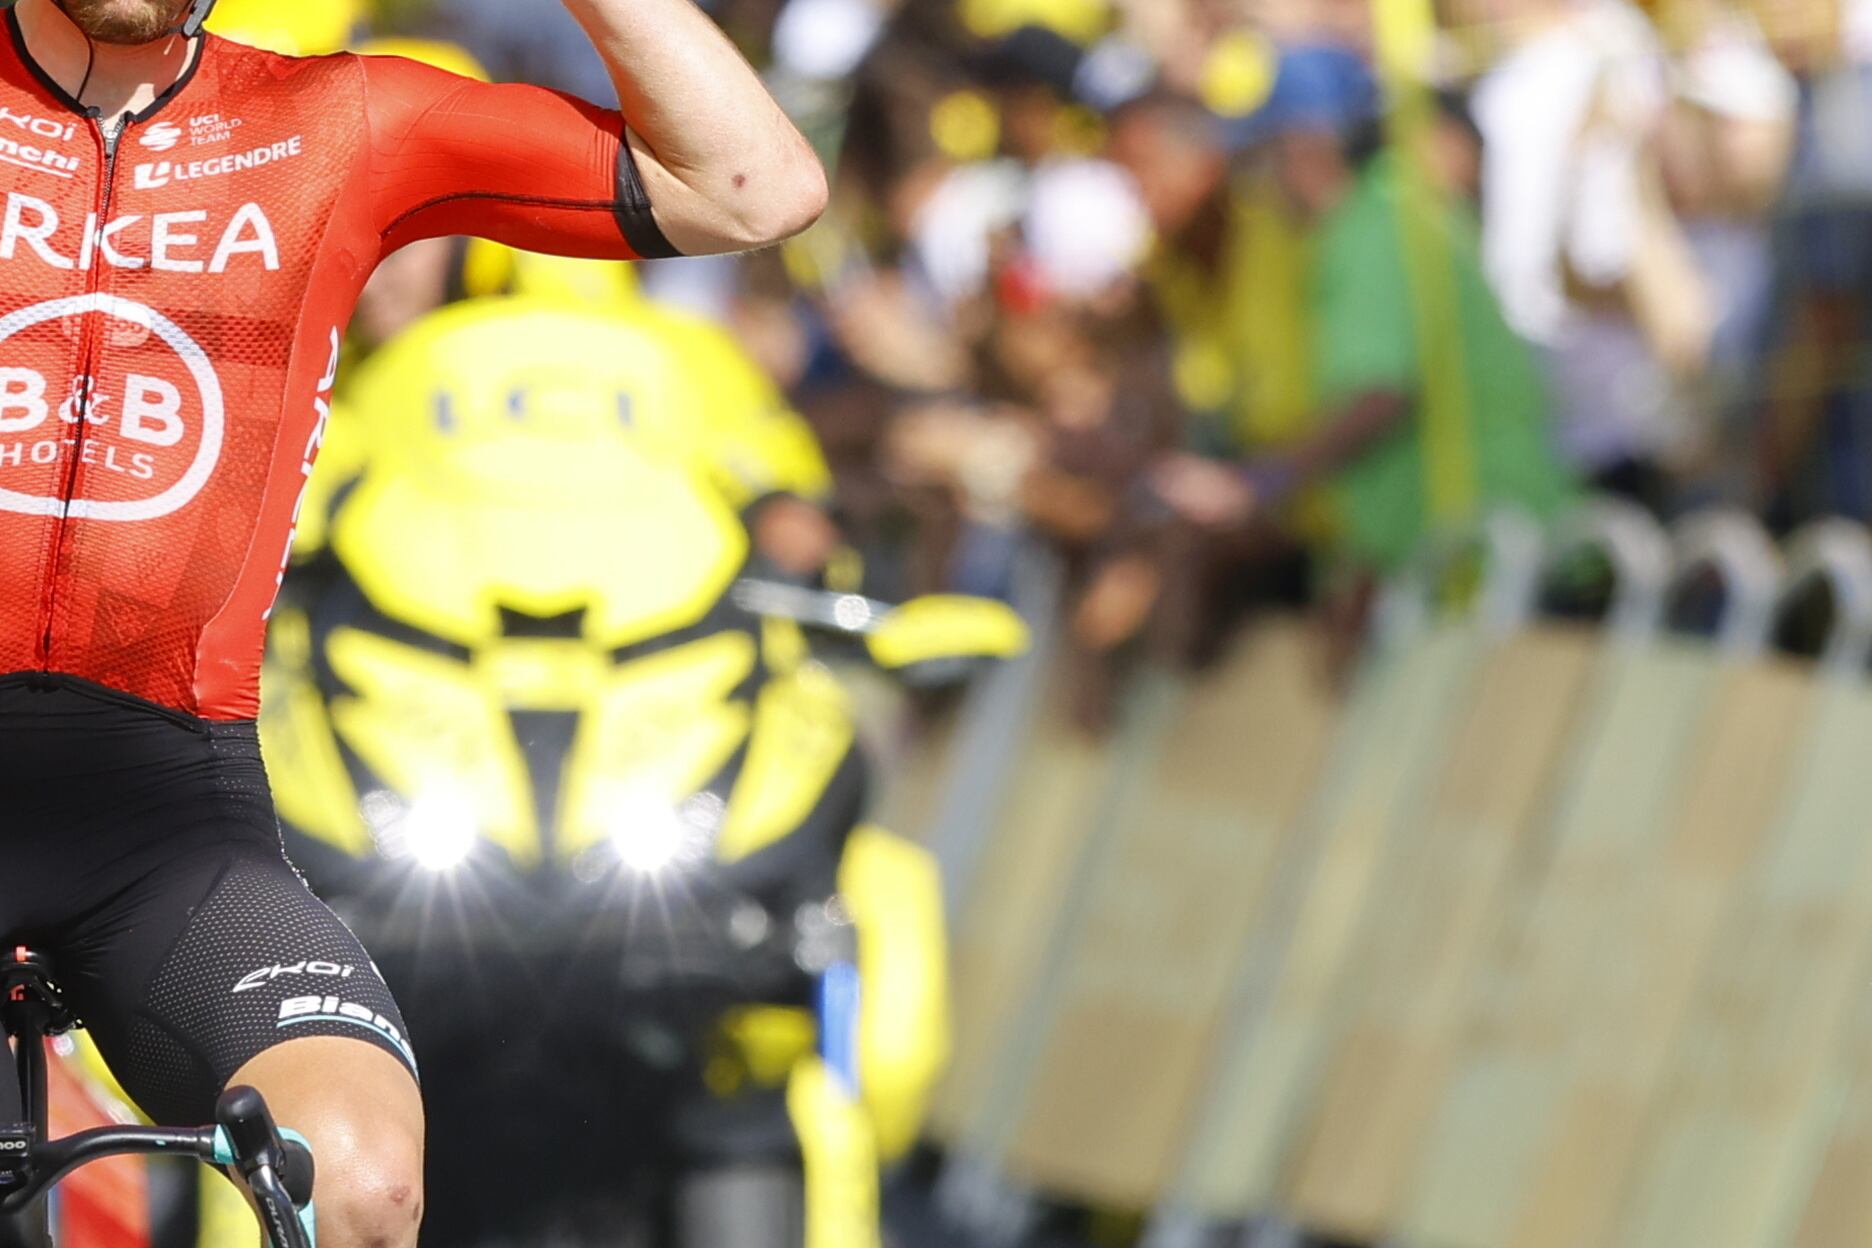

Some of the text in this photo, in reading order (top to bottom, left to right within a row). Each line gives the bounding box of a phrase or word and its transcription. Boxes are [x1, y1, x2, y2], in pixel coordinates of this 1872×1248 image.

[188, 118, 242, 137] WORLD
[189, 113, 220, 127] UCI
[191, 131, 231, 146] TEAM
[175, 135, 302, 180] LEGENDRE
